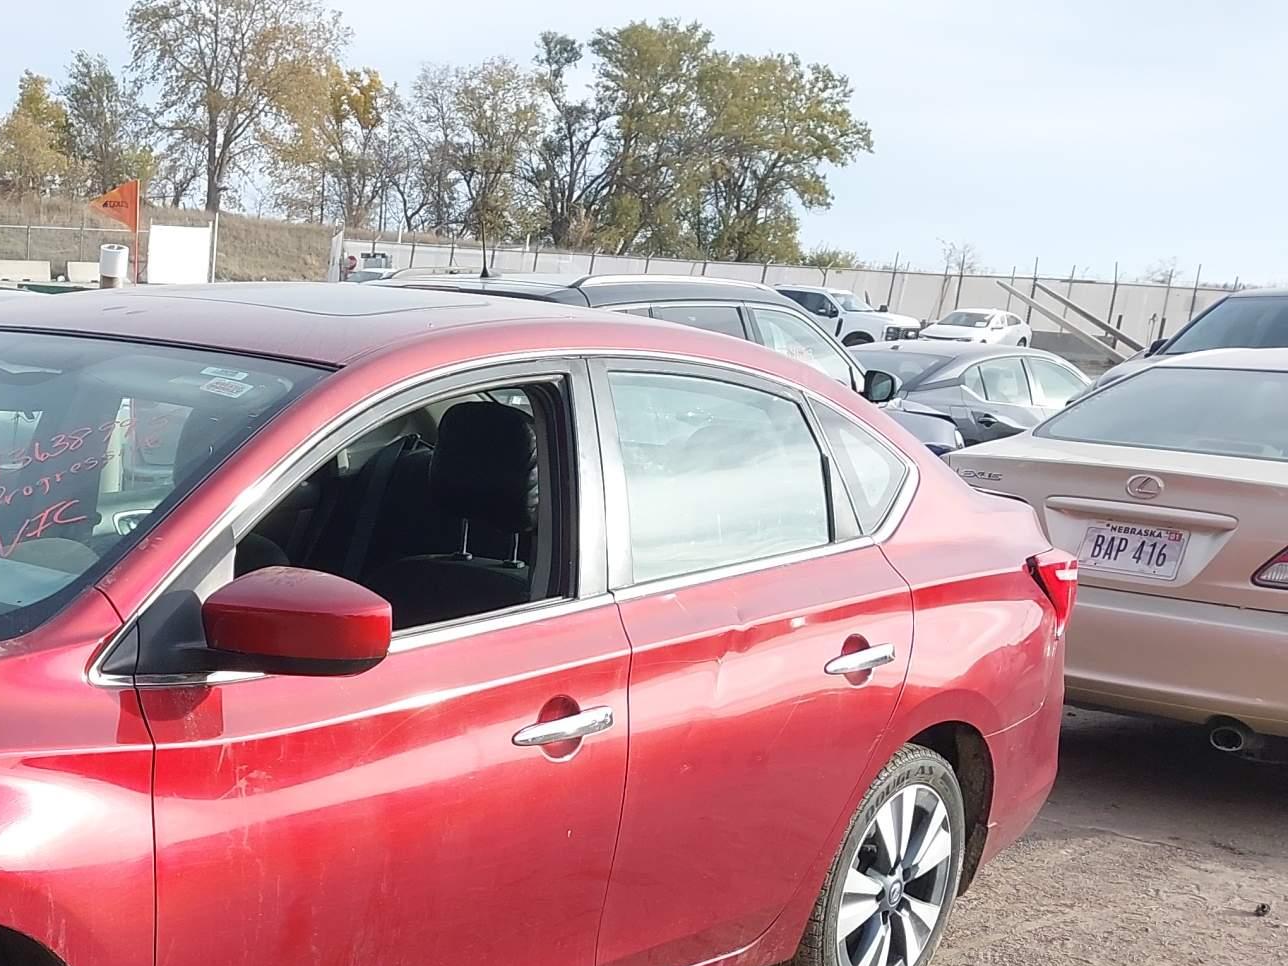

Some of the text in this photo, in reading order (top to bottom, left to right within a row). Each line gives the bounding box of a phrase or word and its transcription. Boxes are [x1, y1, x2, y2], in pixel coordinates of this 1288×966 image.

[1110, 524, 1162, 539] NEBRASKA
[1090, 534, 1167, 568] BAP 416
